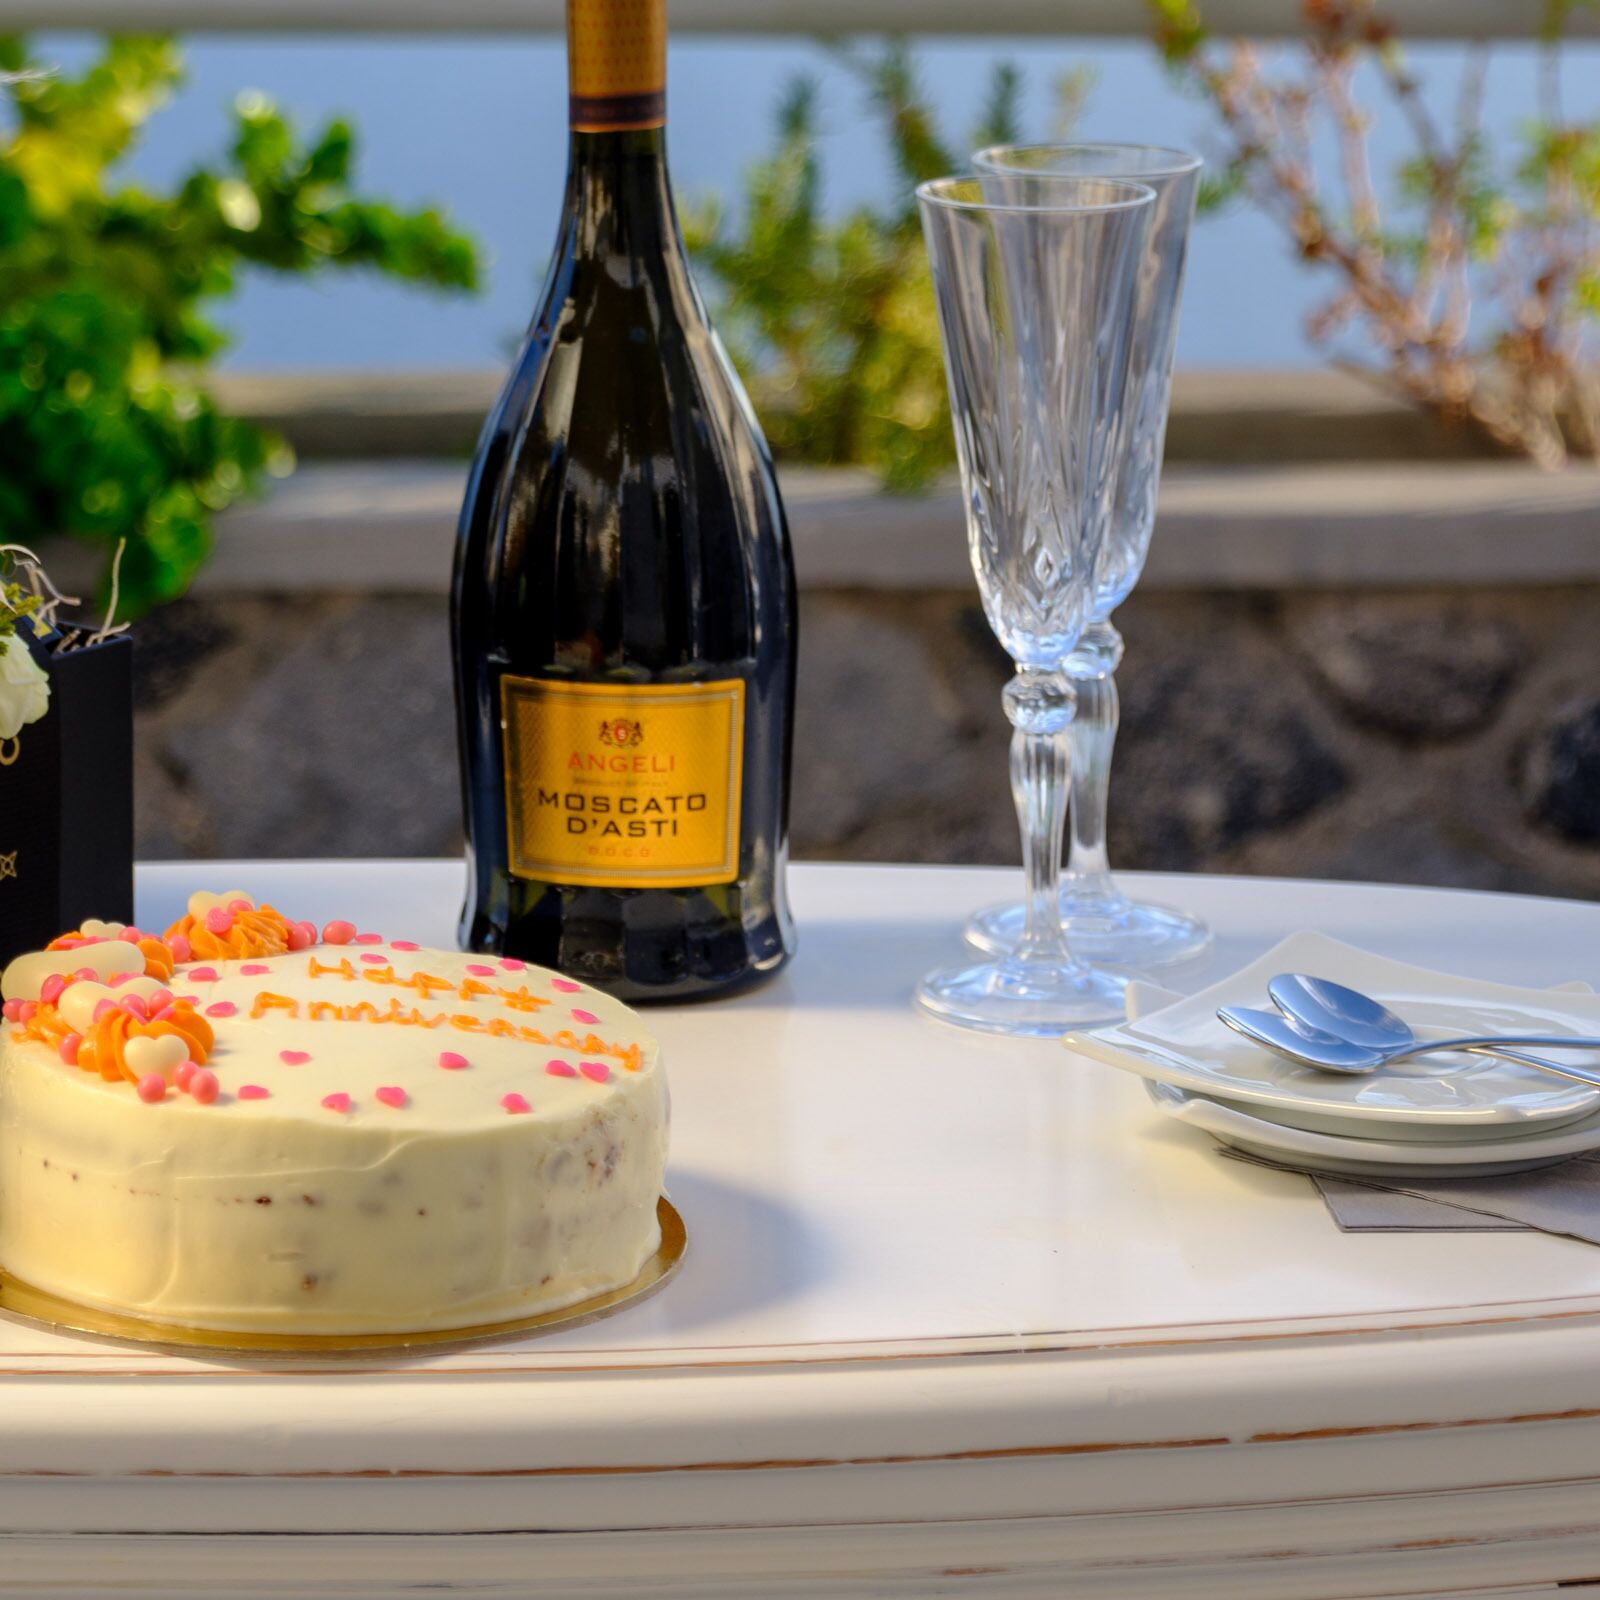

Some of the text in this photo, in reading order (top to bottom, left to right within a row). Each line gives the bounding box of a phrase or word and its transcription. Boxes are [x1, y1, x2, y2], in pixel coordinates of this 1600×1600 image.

[568, 751, 676, 774] ANGELI
[537, 789, 707, 815] MOSCATO
[567, 816, 678, 838] D'ASTI
